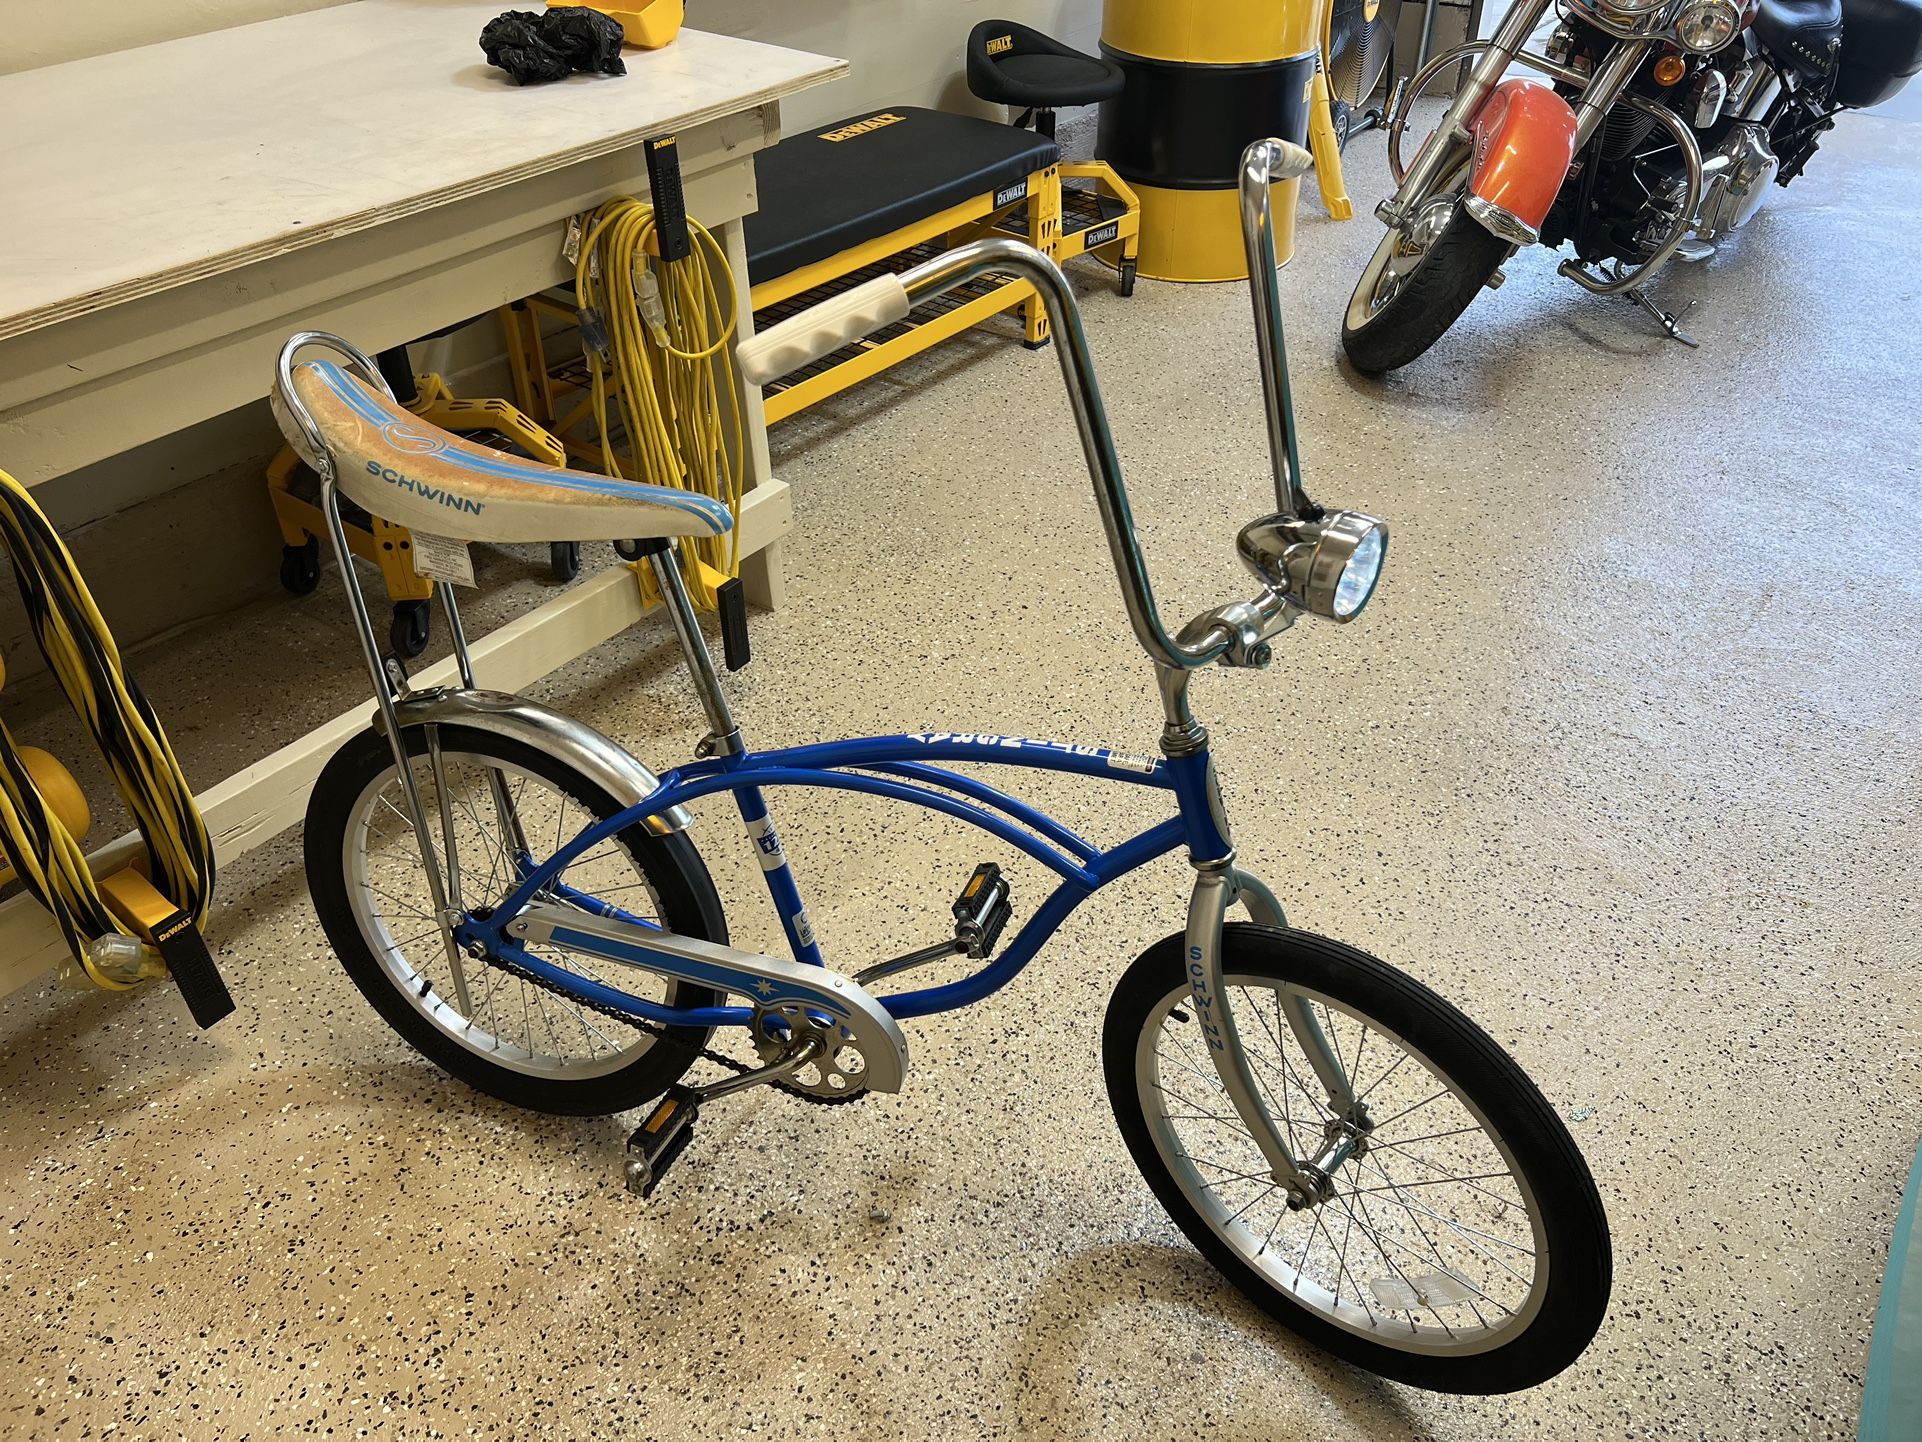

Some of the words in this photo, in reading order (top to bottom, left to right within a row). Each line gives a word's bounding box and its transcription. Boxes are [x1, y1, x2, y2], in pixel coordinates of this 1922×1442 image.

[653, 136, 676, 150] DEWALT
[997, 182, 1026, 206] DEWALT
[1088, 226, 1117, 246] DEWALT
[366, 460, 483, 516] SCHWINN
[158, 917, 192, 942] DEWALT
[1190, 946, 1225, 1051] SCHWINN
